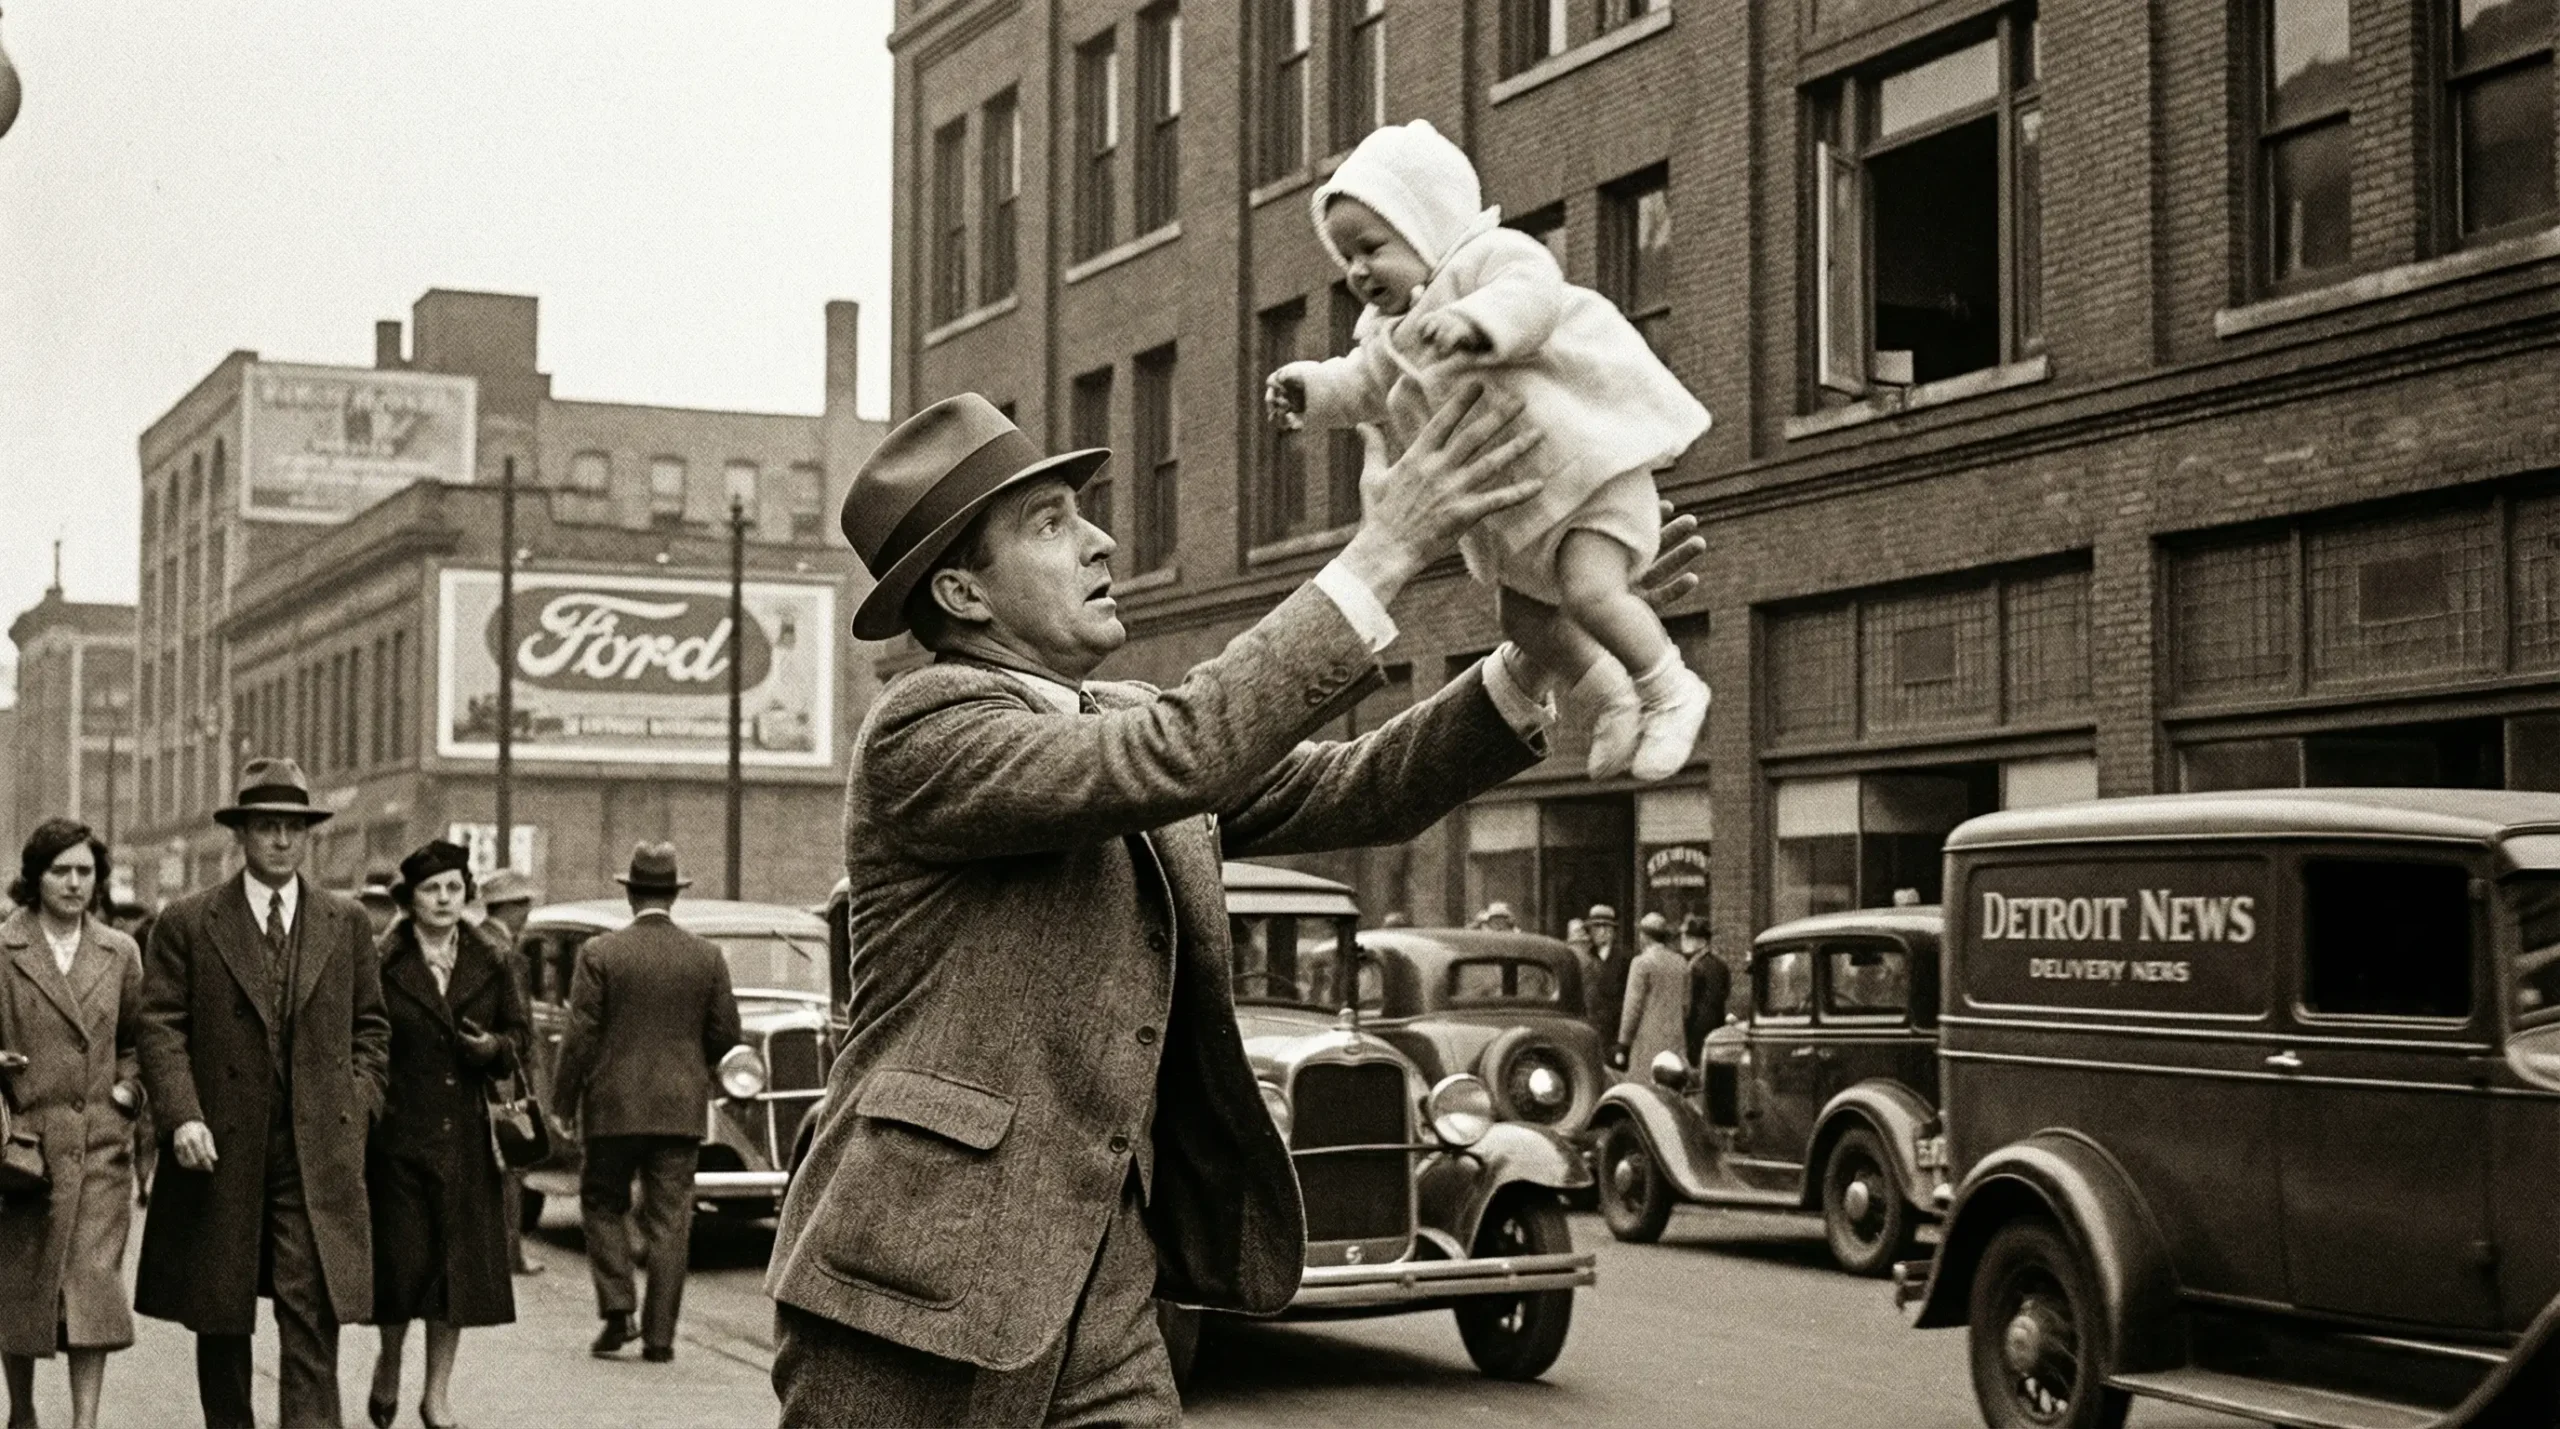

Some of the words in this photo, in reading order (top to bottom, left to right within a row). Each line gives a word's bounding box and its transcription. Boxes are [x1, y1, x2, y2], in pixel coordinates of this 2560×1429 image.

[517, 593, 733, 681] Ford
[1982, 892, 2128, 940] DETROIT
[2139, 889, 2255, 943] NEWS
[2029, 958, 2126, 981] DELIVERY
